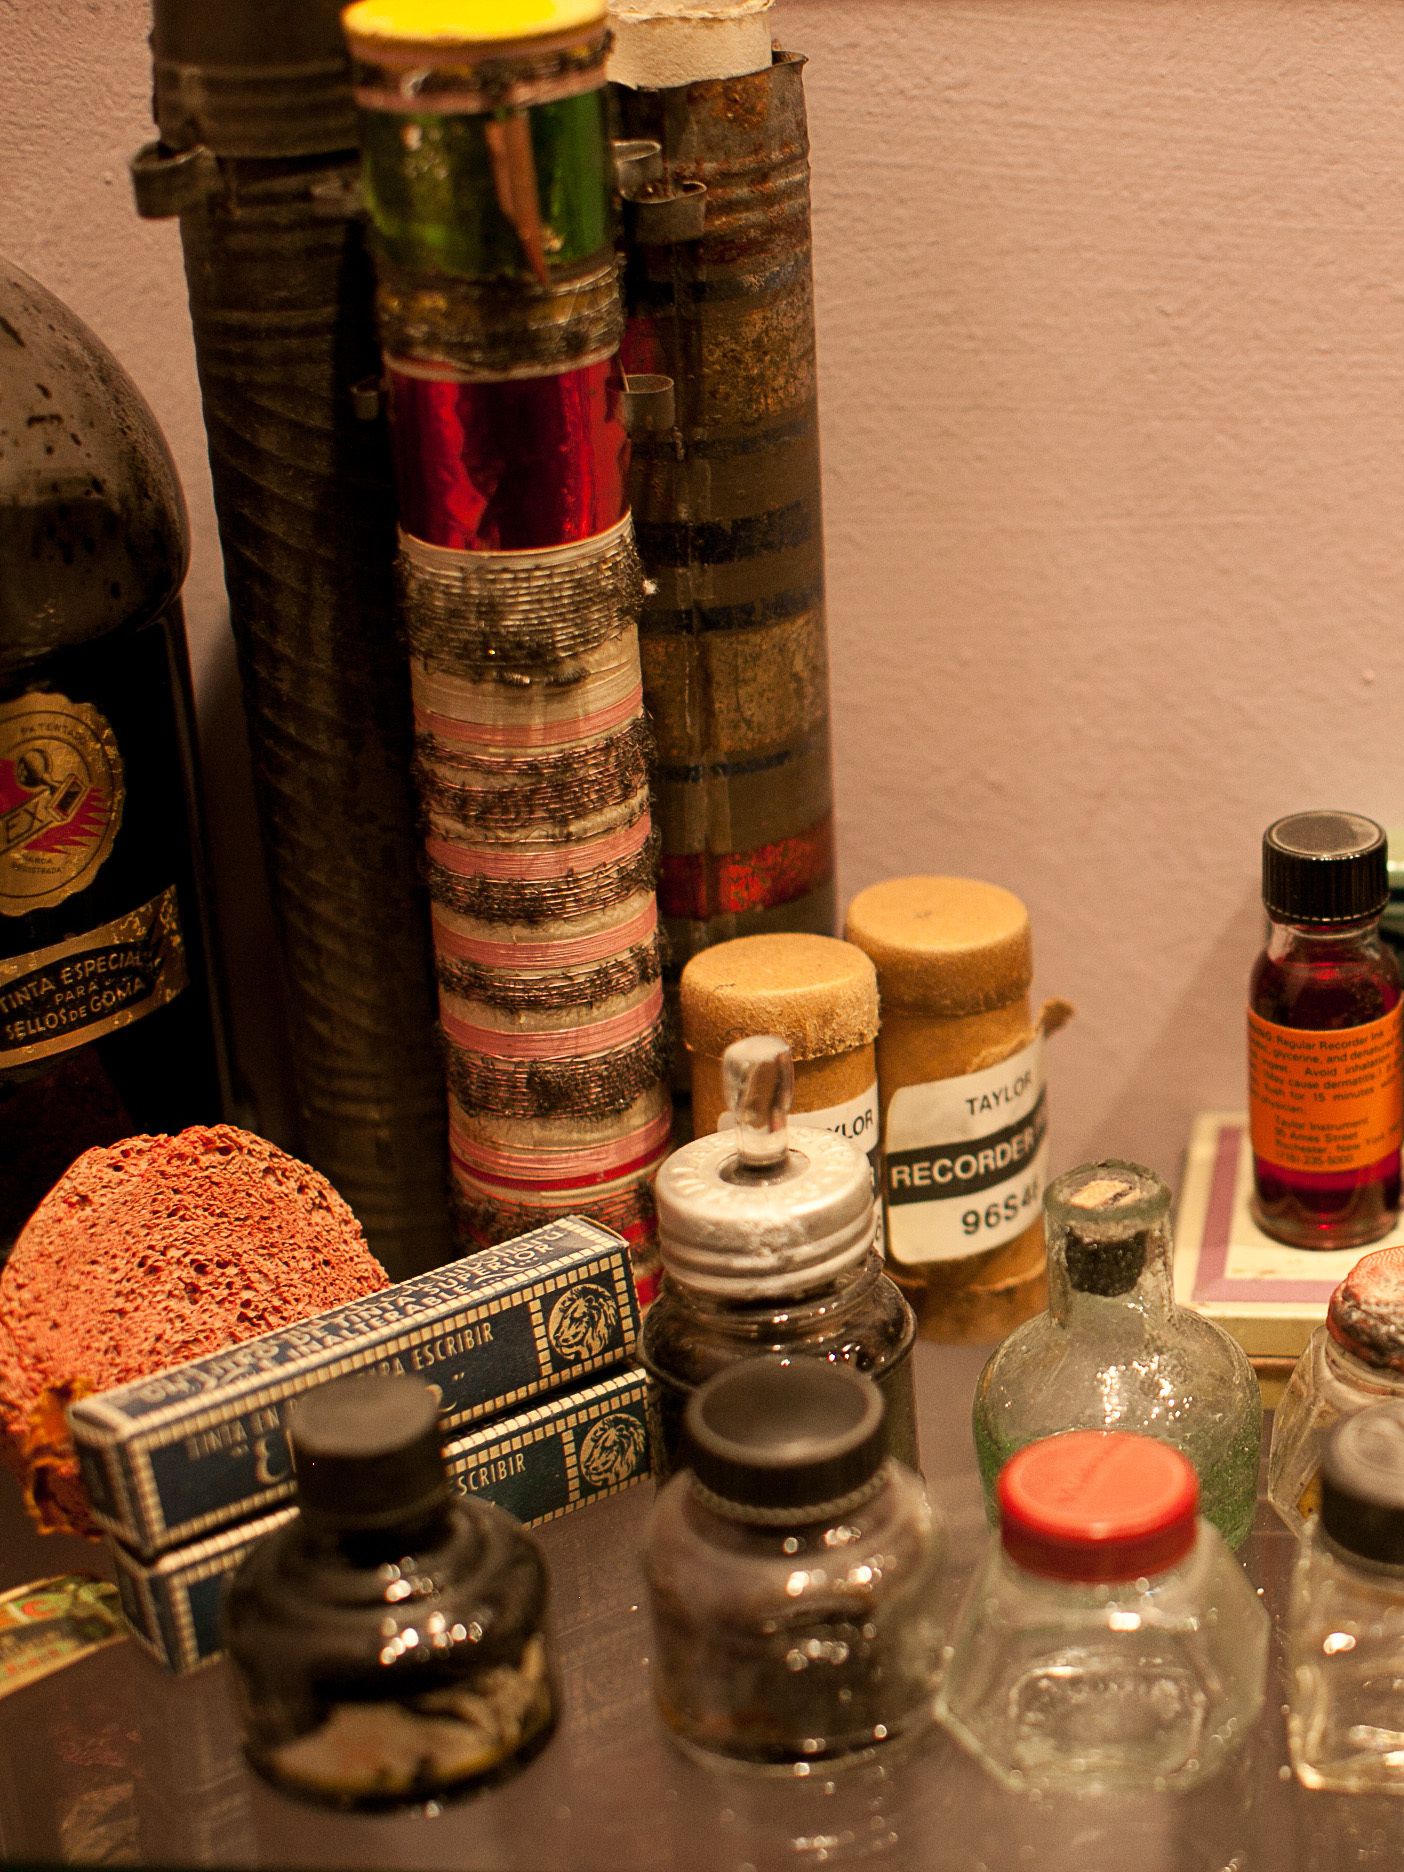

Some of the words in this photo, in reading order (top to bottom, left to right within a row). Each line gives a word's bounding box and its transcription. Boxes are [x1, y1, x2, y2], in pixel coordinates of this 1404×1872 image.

[0, 977, 56, 1014] TINTA
[60, 950, 145, 985] ESPECIAL
[54, 979, 100, 1006] PARA
[5, 1007, 68, 1041] SELLOS
[69, 1004, 88, 1022] DE
[90, 976, 147, 1013] GOMA
[1277, 1035, 1316, 1050] Regular
[1319, 1036, 1368, 1050] Recorder
[966, 1070, 1032, 1116] TAYLOR
[1288, 1078, 1319, 1089] cause
[1304, 1067, 1337, 1077] Avoid
[1313, 1092, 1326, 1103] 15
[891, 1127, 1034, 1189] RECORDER
[336, 1295, 417, 1332] TINTA
[424, 1241, 555, 1296] SUPERIOR
[285, 1283, 474, 1359] INALTERABLE
[411, 1321, 495, 1371] ESCRIBIR
[456, 1452, 527, 1497] SCRIBIR
